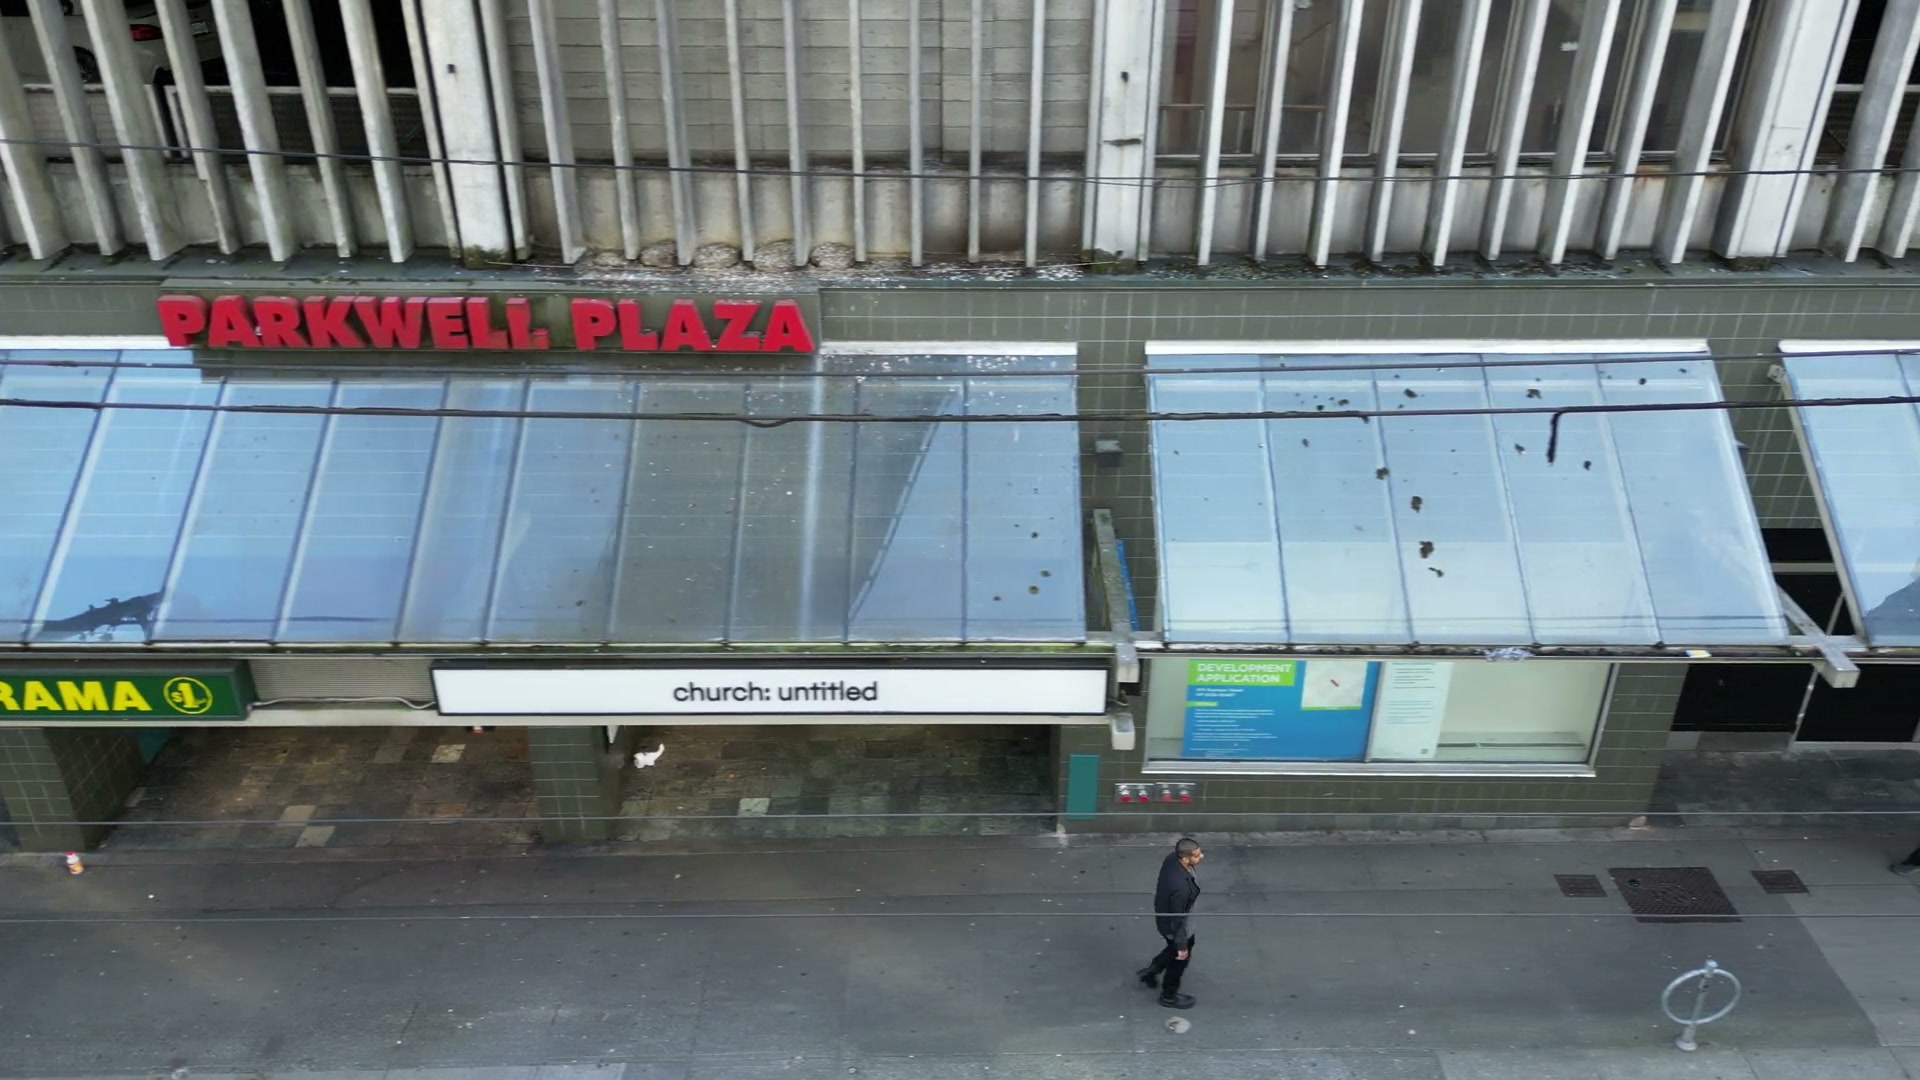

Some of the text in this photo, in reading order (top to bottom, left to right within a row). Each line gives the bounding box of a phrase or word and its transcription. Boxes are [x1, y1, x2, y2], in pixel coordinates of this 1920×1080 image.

[157, 295, 815, 351] PARKWELL PLAZA
[1196, 663, 1292, 673] DEVELOPMENT
[1196, 673, 1281, 683] APPLICATION
[673, 680, 878, 702] church: untitled
